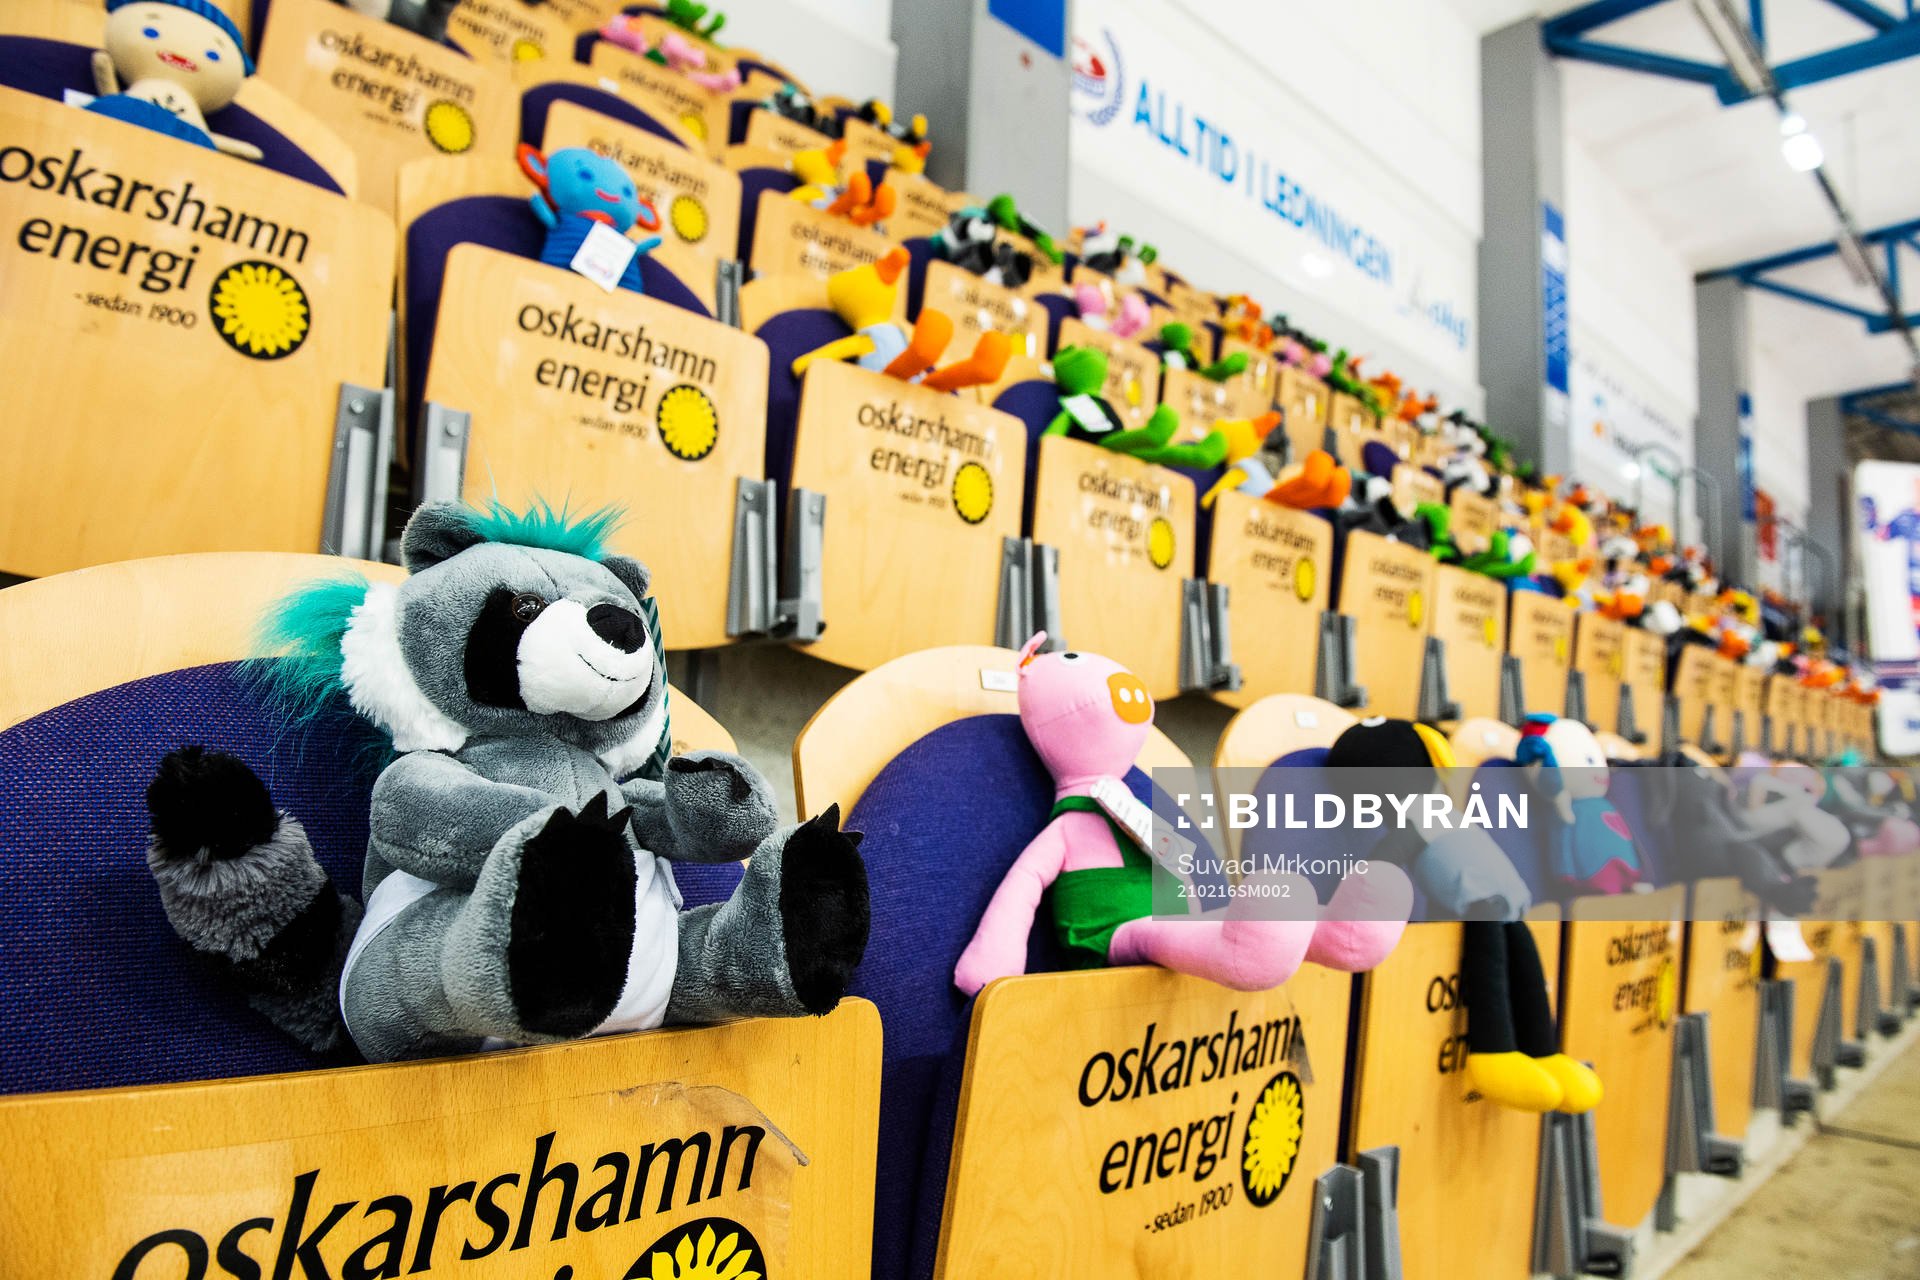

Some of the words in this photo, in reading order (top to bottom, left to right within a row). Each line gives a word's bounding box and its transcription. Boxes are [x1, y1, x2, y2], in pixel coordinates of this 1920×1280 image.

[318, 28, 476, 102] oskarshamn
[332, 66, 420, 113] energi
[1133, 80, 1239, 183] ALLTID
[0, 145, 311, 264] oskarshamn
[17, 216, 202, 294] energi
[148, 302, 198, 329] 1900
[518, 303, 717, 386] oskarshamn
[536, 356, 650, 414] energi
[870, 446, 948, 488] energi
[1099, 1091, 1240, 1194] energi
[110, 1125, 766, 1280] oskarshamn
[1199, 1182, 1234, 1217] 1900
